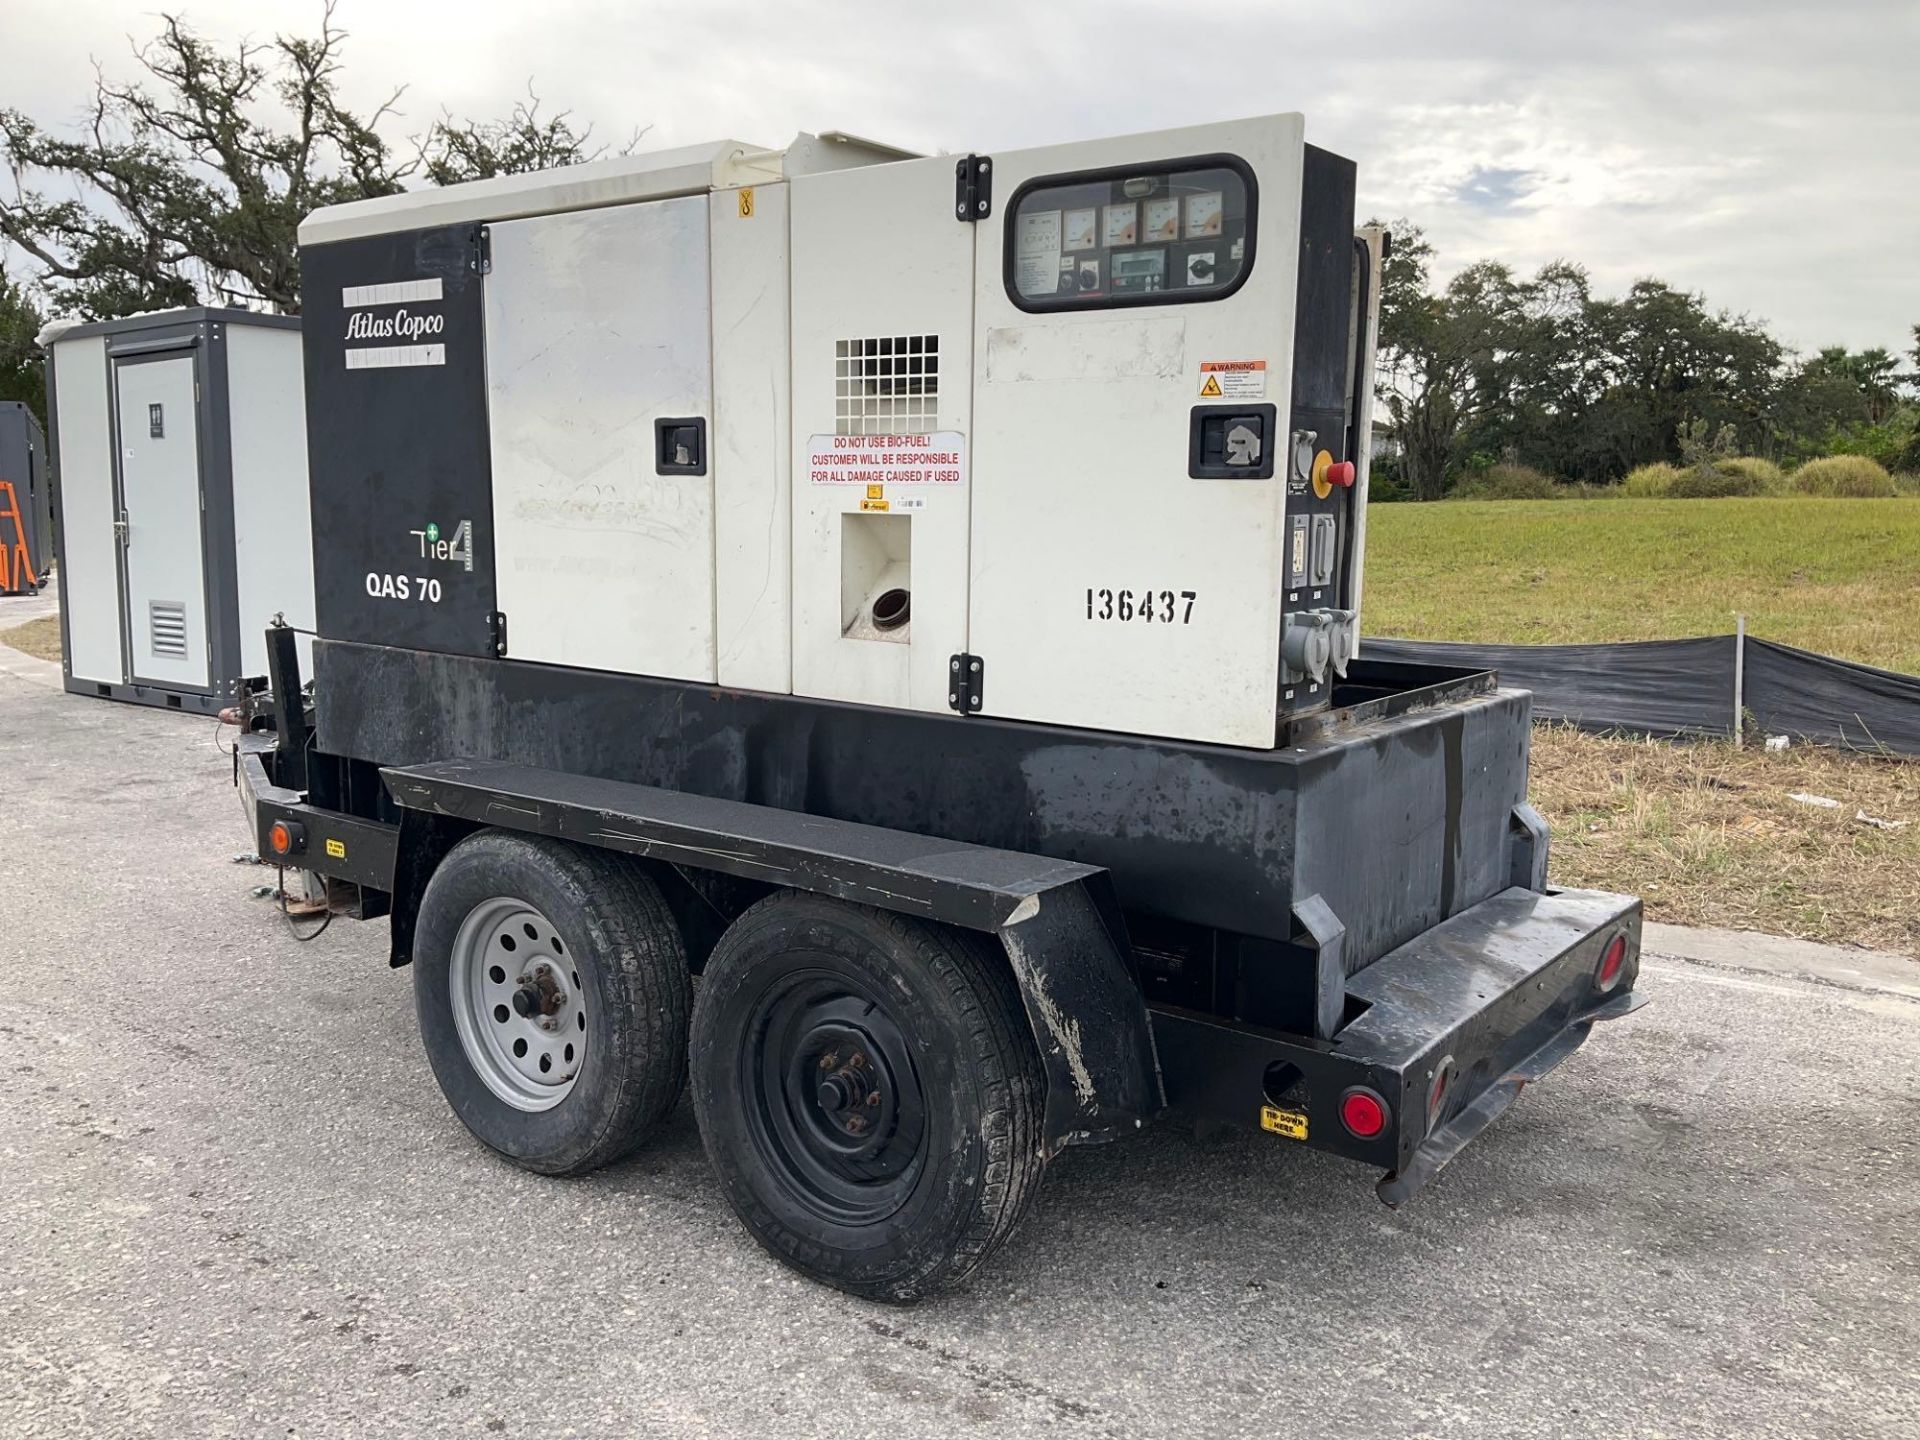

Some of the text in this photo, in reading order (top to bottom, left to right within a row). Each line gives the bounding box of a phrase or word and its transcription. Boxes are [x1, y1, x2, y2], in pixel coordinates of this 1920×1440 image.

[344, 309, 444, 341] Atlas Copco
[1217, 363, 1256, 371] WARNING
[834, 436, 930, 449] DO NOT USE BIO-FUEL!
[812, 452, 959, 466] CUSTOMER WILL BE RESPONSIBLE
[811, 470, 960, 482] FOR ALL DAMAGE CAUSED IF USED
[366, 572, 441, 603] QAS 70
[1087, 588, 1197, 625] 136437
